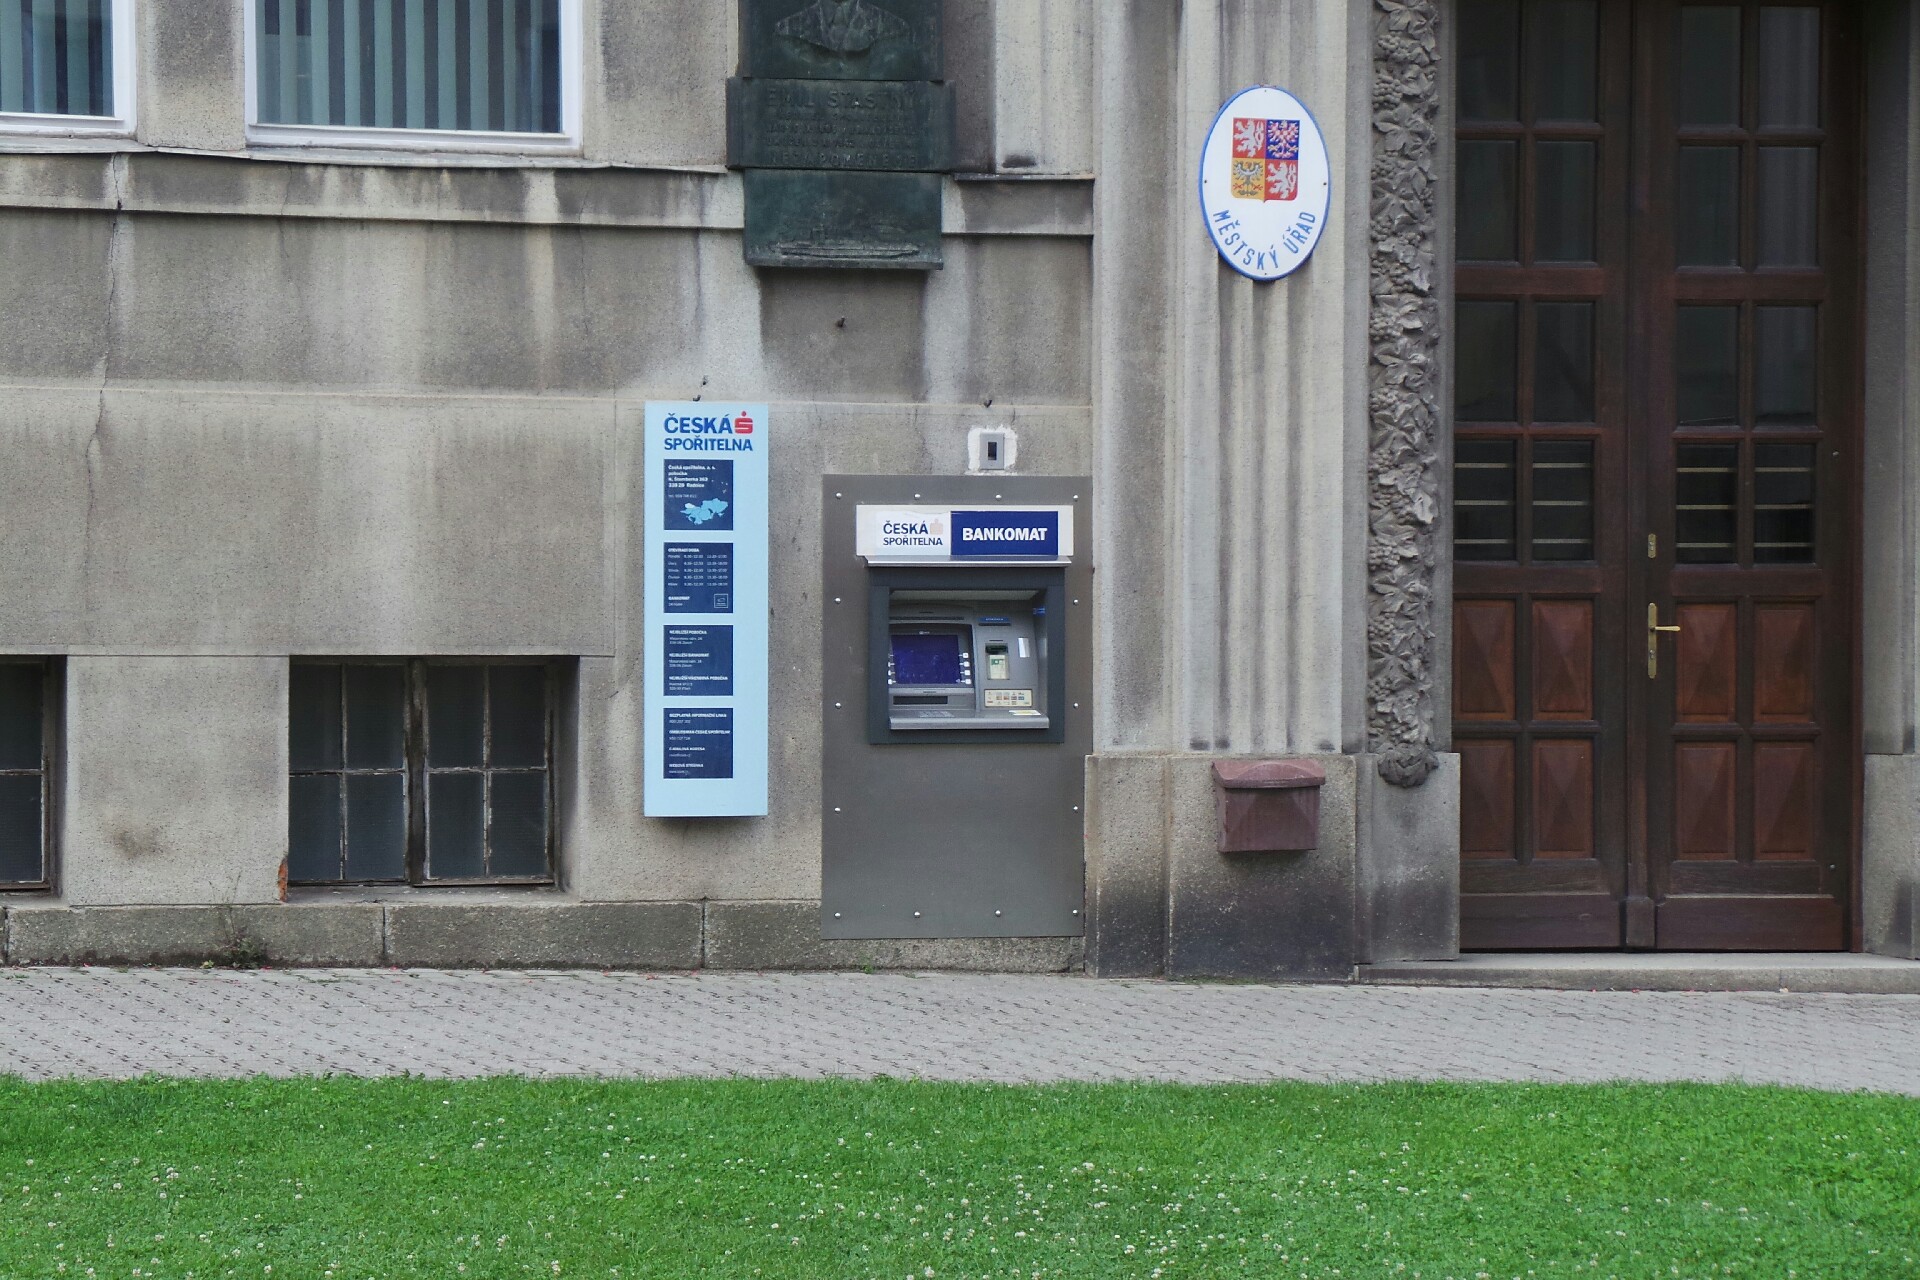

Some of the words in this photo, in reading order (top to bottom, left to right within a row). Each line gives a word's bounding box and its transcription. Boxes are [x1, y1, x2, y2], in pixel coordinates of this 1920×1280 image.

[1213, 210, 1278, 270] MĚSTSKÝ
[1282, 211, 1316, 254] ÚŘAD
[664, 412, 733, 434] ČESKÁ
[664, 435, 753, 451] SPOŘITELNA
[883, 520, 928, 535] ČESKÁ
[962, 527, 1048, 541] BANKOMAT
[883, 535, 943, 546] SPOŘITELNA
